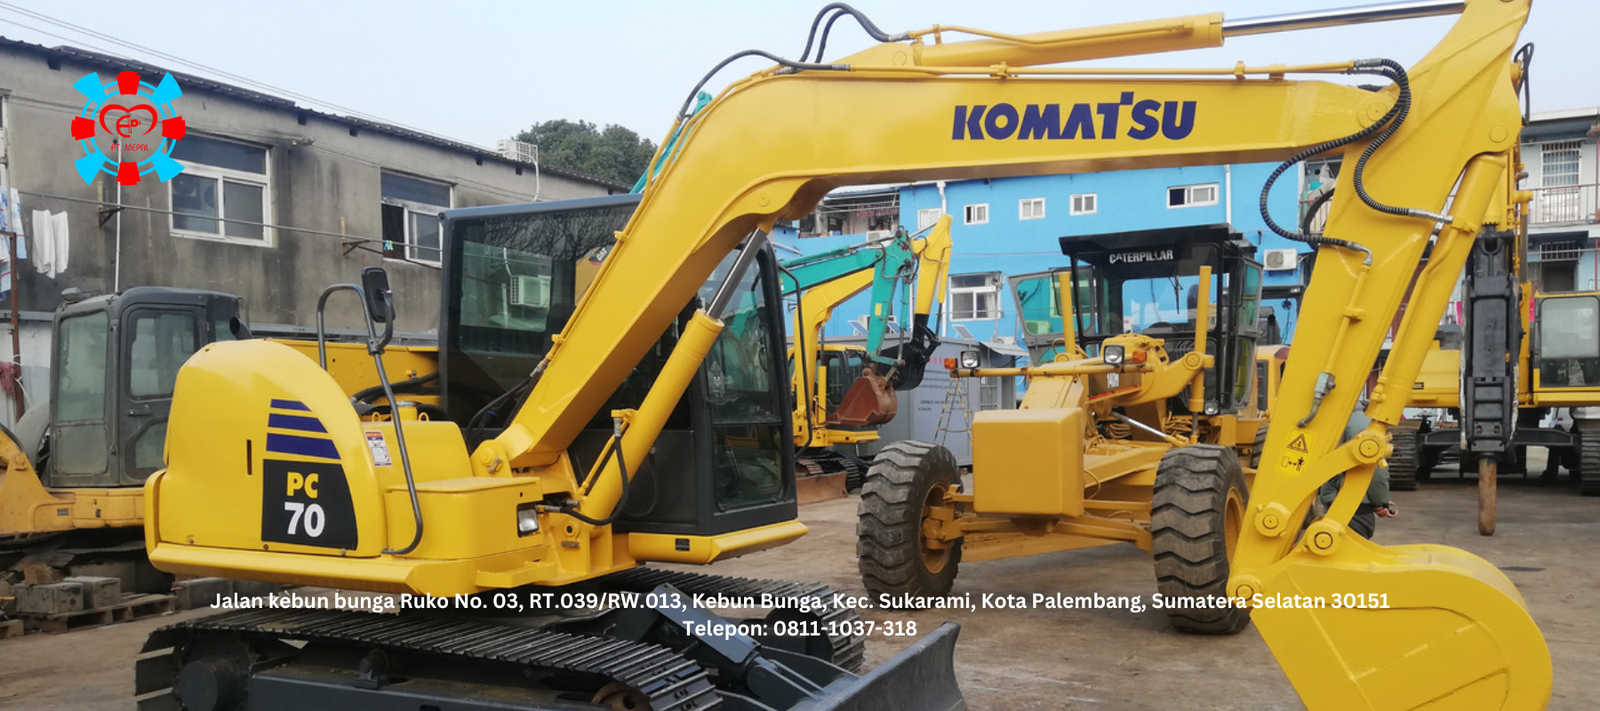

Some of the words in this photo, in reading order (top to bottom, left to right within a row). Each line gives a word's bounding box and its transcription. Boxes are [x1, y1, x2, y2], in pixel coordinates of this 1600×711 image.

[952, 90, 1196, 140] KOMATSU
[1109, 249, 1174, 264] CATERPILLAR
[286, 472, 319, 499] PC
[284, 502, 325, 537] 70
